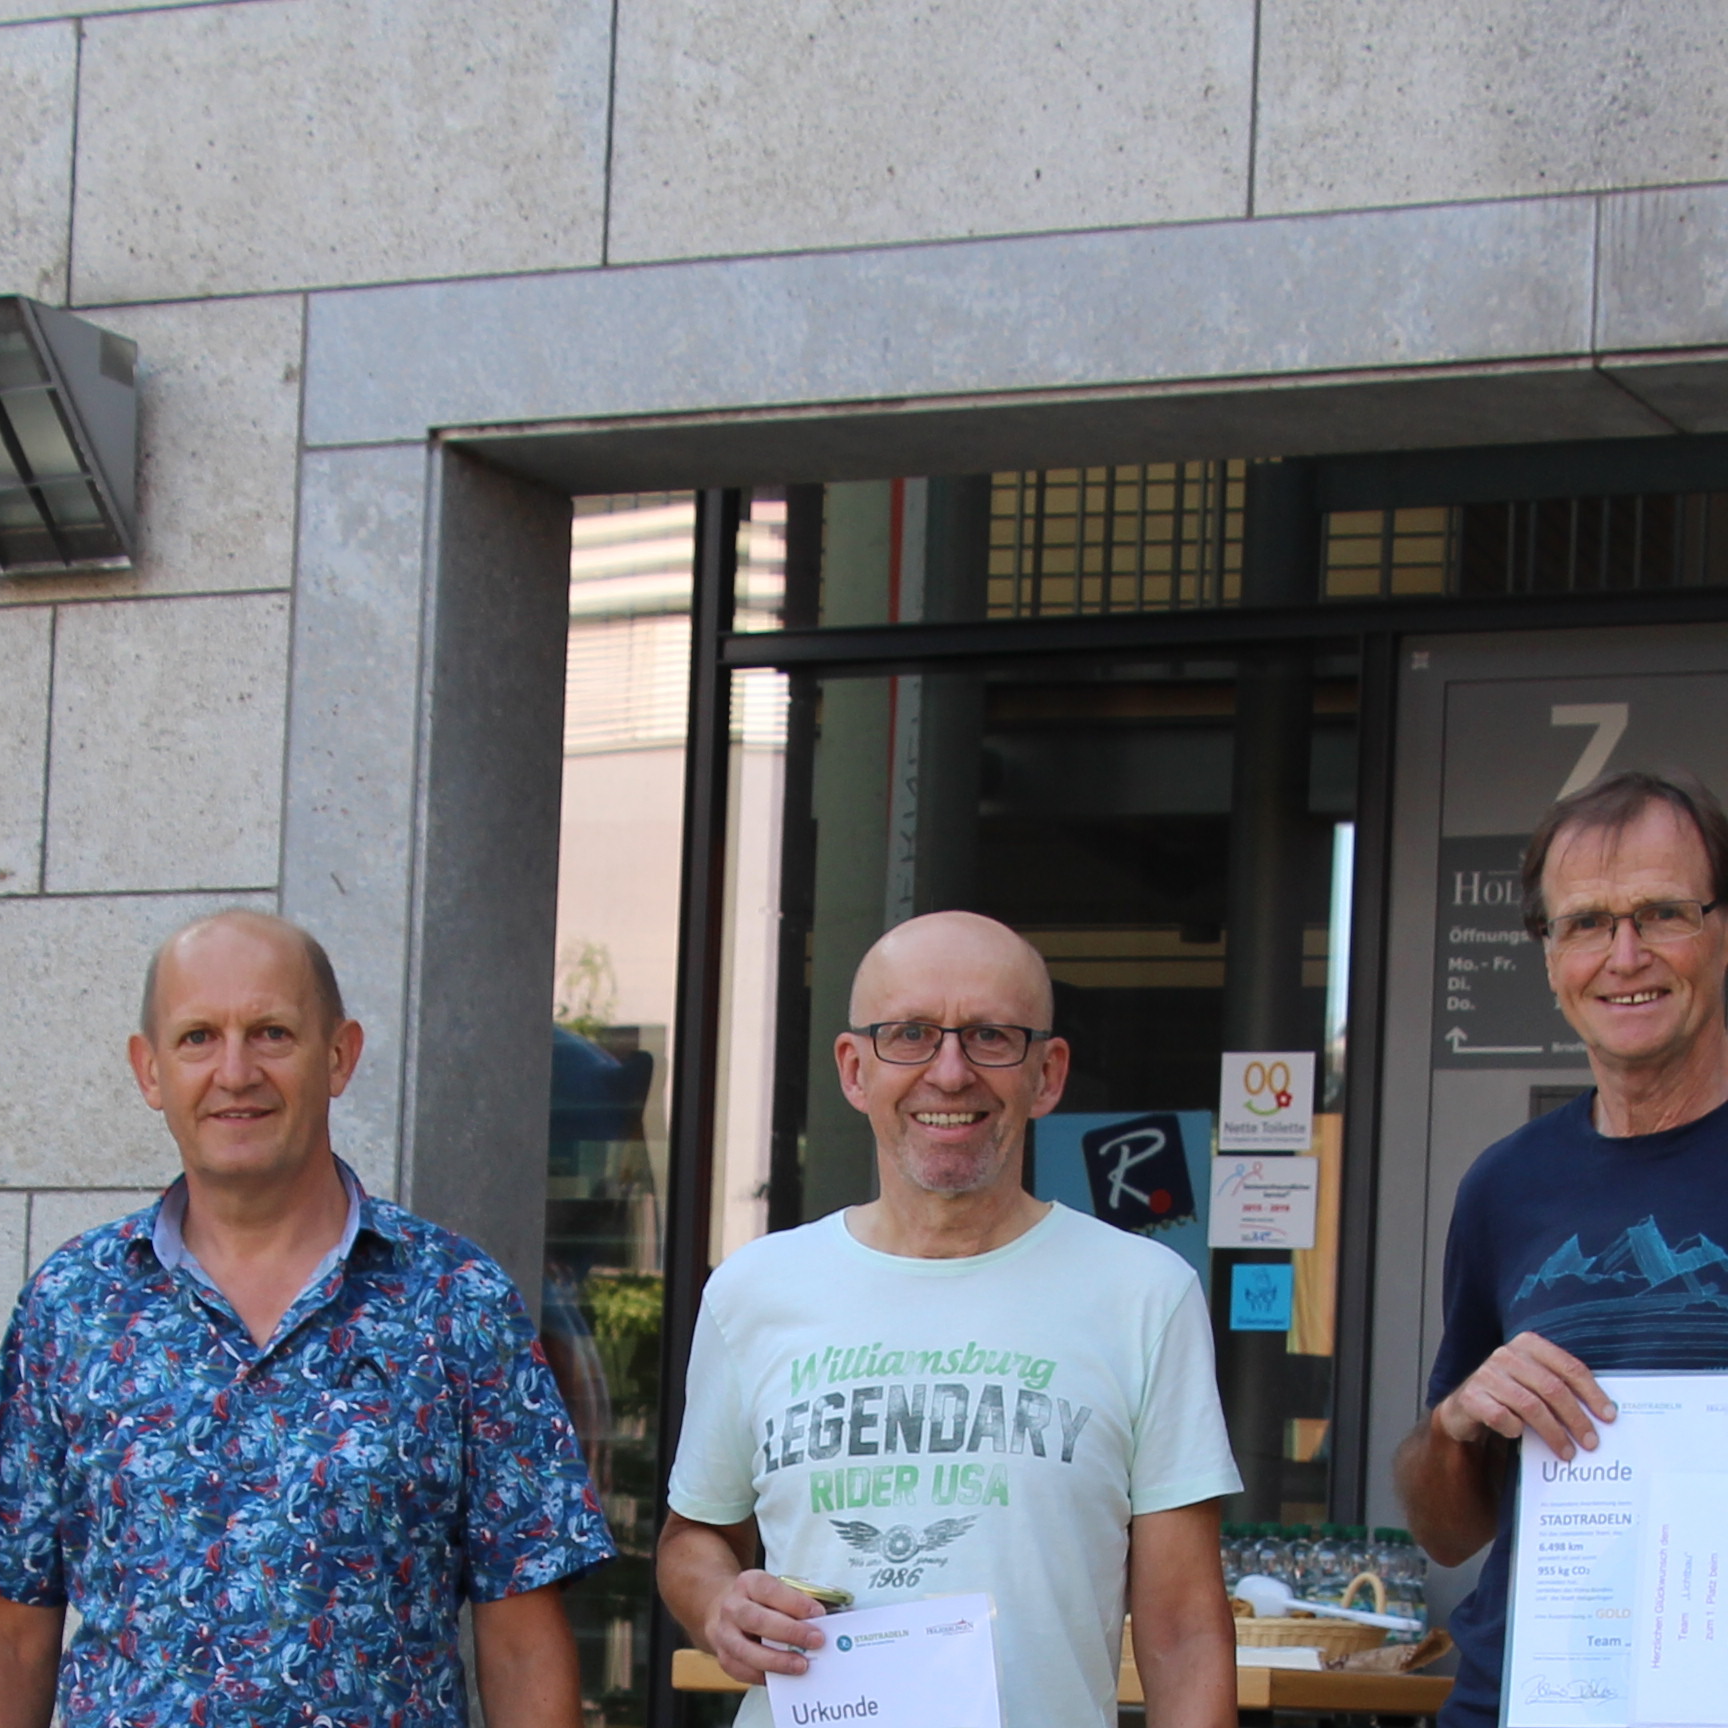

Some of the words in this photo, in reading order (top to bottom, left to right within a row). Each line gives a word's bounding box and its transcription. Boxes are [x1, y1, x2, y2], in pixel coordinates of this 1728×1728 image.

[1551, 702, 1629, 801] 7
[1449, 925, 1530, 945] Öffnungs
[1448, 957, 1478, 971] Mo.
[1493, 957, 1516, 971] Fr.
[1447, 977, 1471, 990] Di.
[1446, 997, 1475, 1011] Do.
[1224, 1121, 1257, 1134] Nette
[1261, 1121, 1306, 1134] Toilette
[791, 1340, 1057, 1397] Williamsburg
[763, 1383, 1092, 1474] LEGENDARY
[1542, 1459, 1633, 1483] Urkunde
[809, 1464, 919, 1514] RIDER
[931, 1463, 1009, 1507] USA
[1540, 1513, 1632, 1526] STADTRADELN
[1660, 1524, 1670, 1546] dem
[1568, 1542, 1584, 1552] km
[1558, 1566, 1570, 1577] kg
[1709, 1552, 1718, 1577] beim
[868, 1567, 924, 1589] 1986
[1654, 1548, 1668, 1614] Glückwunsch
[1706, 1580, 1717, 1605] Platz
[1595, 1608, 1632, 1619] GOLD
[854, 1629, 910, 1643] STADTRADELN
[1678, 1612, 1689, 1641] Team
[1706, 1619, 1715, 1641] zum
[1587, 1635, 1622, 1648] Team
[1651, 1616, 1663, 1669] Herzlichen
[792, 1695, 879, 1726] Urkunde
